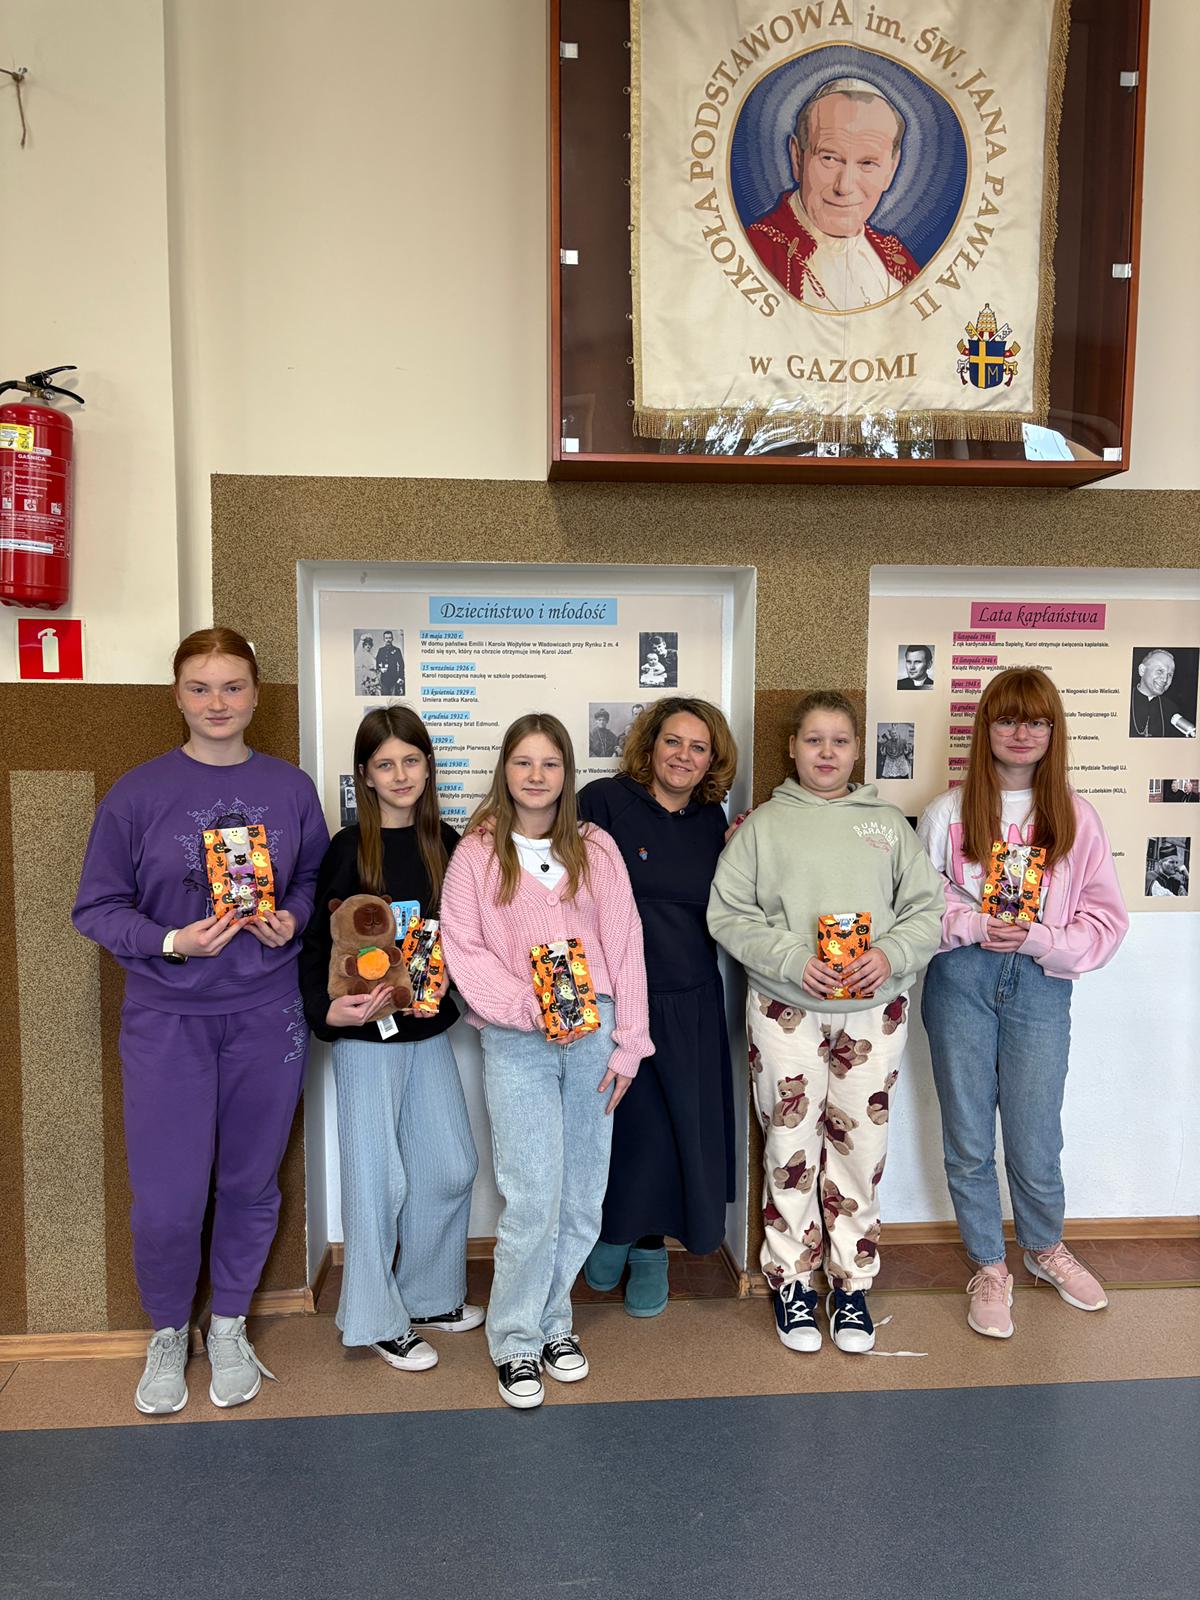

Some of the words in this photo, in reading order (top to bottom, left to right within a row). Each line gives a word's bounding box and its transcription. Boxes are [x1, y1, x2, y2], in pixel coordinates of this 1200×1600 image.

[865, 5, 907, 43] im.
[914, 25, 966, 79] ŚW.
[690, 0, 853, 183] PODSTAWOWA
[955, 67, 1008, 164] JANA
[936, 174, 1006, 291] PAWŁA
[694, 187, 781, 318] SZKOŁA
[910, 294, 942, 322] II
[786, 352, 918, 384] GAZOMI
[987, 365, 999, 383] M
[440, 602, 534, 619] Dzieciństwo
[538, 603, 544, 619] i
[549, 602, 607, 620] młodość
[978, 606, 1012, 622] Lata
[1016, 605, 1098, 628] kapłaństwa
